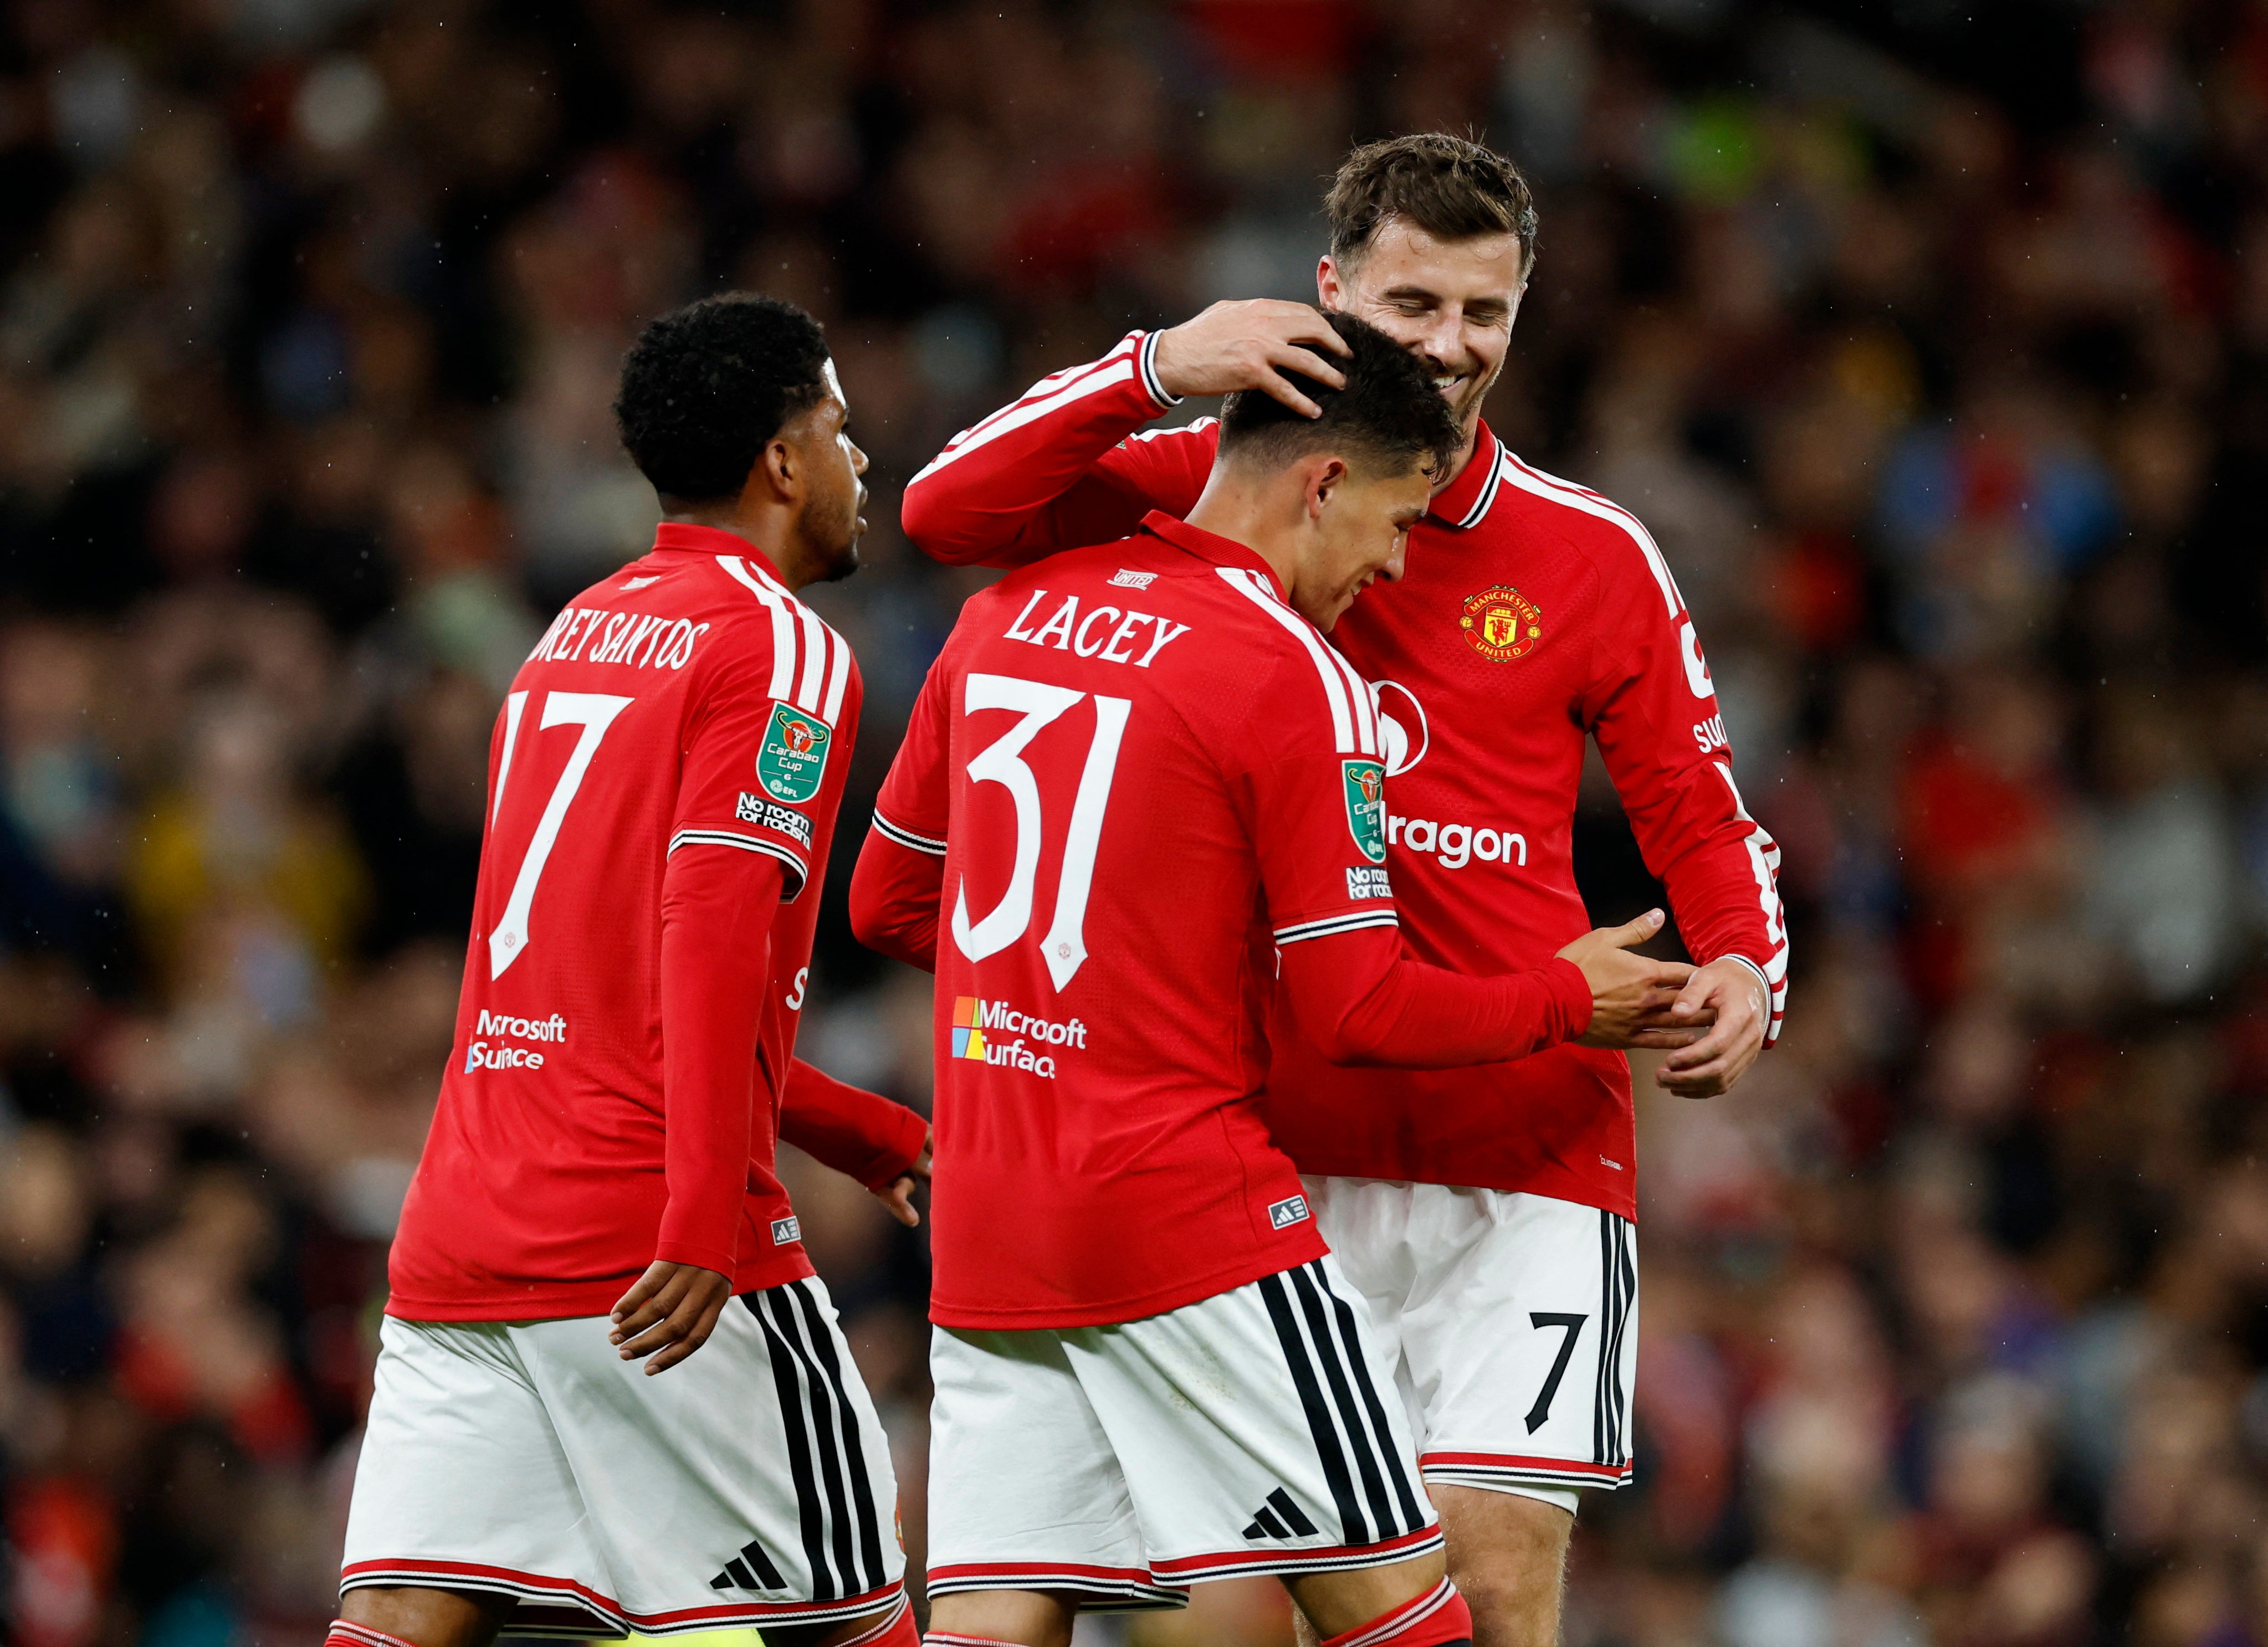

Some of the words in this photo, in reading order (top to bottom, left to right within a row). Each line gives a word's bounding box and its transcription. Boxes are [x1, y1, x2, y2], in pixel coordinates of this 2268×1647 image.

[1114, 572, 1153, 586] UNITED
[1470, 592, 1534, 620] MANCHESTER
[589, 612, 710, 670] SANTOS
[1002, 589, 1192, 668] LACEY
[1476, 642, 1521, 658] UNITED
[767, 742, 820, 763] Carabao
[778, 757, 803, 772] Cup
[782, 786, 798, 798] EFL
[735, 805, 762, 823] for
[763, 815, 811, 851] racism
[738, 792, 764, 813] No
[766, 804, 810, 833] room
[951, 673, 1132, 994] 31
[1379, 801, 1527, 869] ragon
[1346, 866, 1370, 884] No
[1348, 882, 1371, 900] for
[980, 999, 1087, 1049] Microoft
[1524, 1312, 1590, 1435] 7
